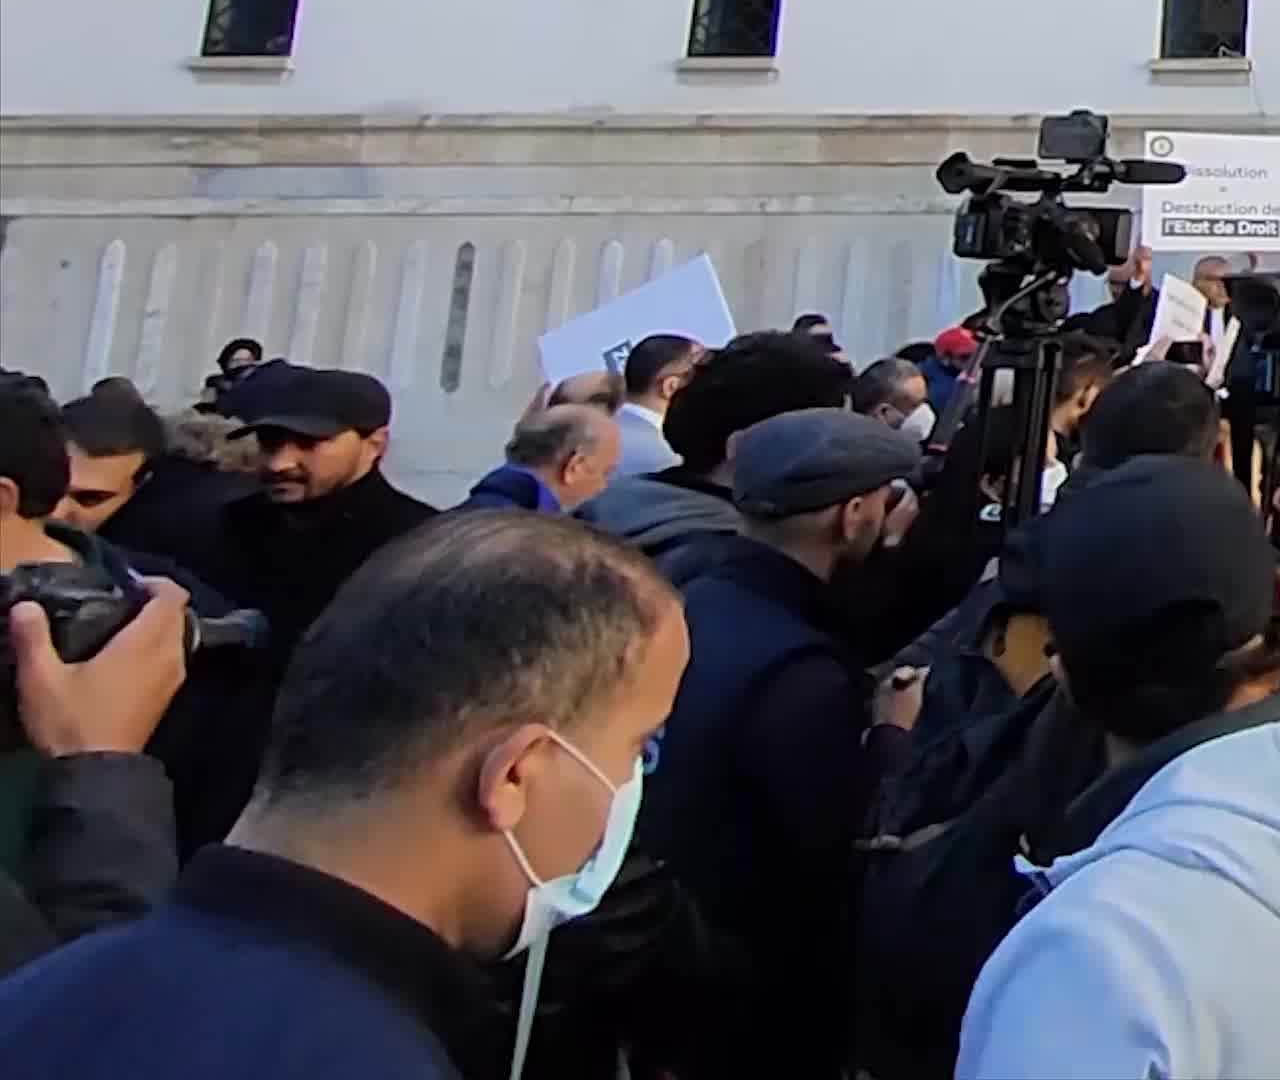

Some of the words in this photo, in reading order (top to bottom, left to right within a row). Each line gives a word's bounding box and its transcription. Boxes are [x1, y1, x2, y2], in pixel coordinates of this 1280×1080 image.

[1161, 200, 1257, 216] Destruction
[1262, 201, 1280, 216] de
[1165, 220, 1210, 235] l'Etat
[1212, 221, 1235, 234] de
[1237, 220, 1278, 236] Droit
